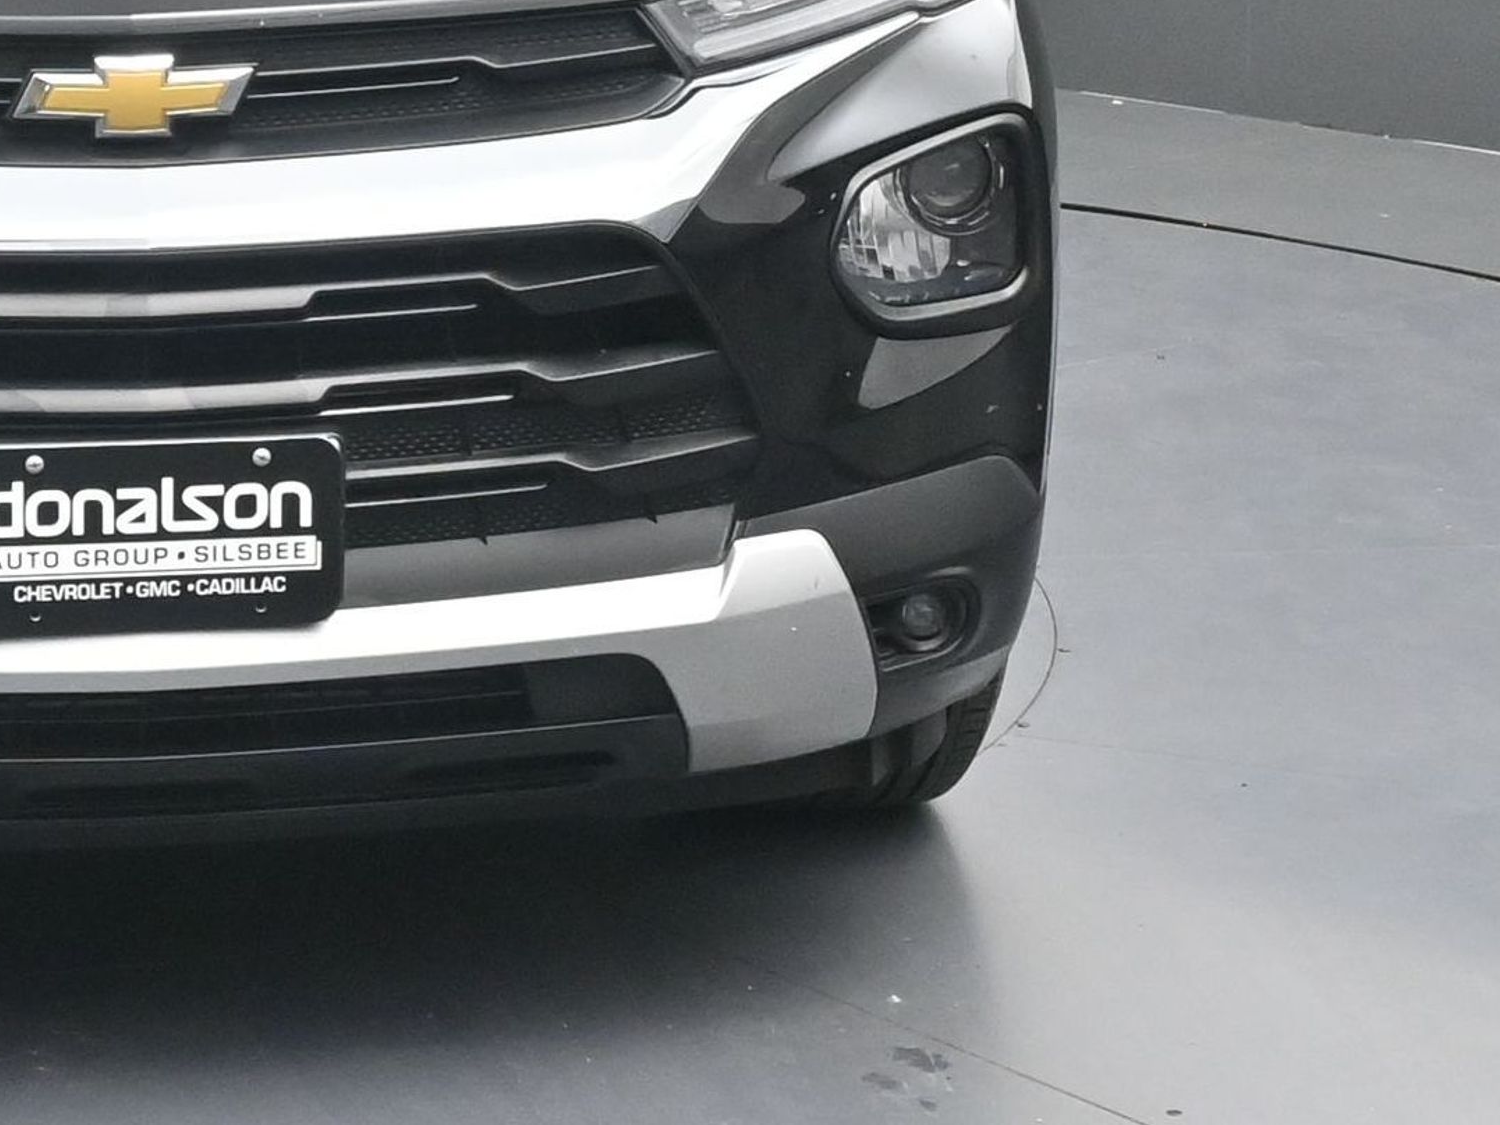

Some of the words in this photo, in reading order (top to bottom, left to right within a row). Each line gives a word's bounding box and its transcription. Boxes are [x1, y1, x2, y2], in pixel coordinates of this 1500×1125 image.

[74, 546, 169, 567] GROUP
[194, 541, 307, 563] SILSBEE
[13, 581, 124, 603] CHEVROLET
[135, 578, 181, 598] GMC
[194, 575, 287, 596] CADILLAC
